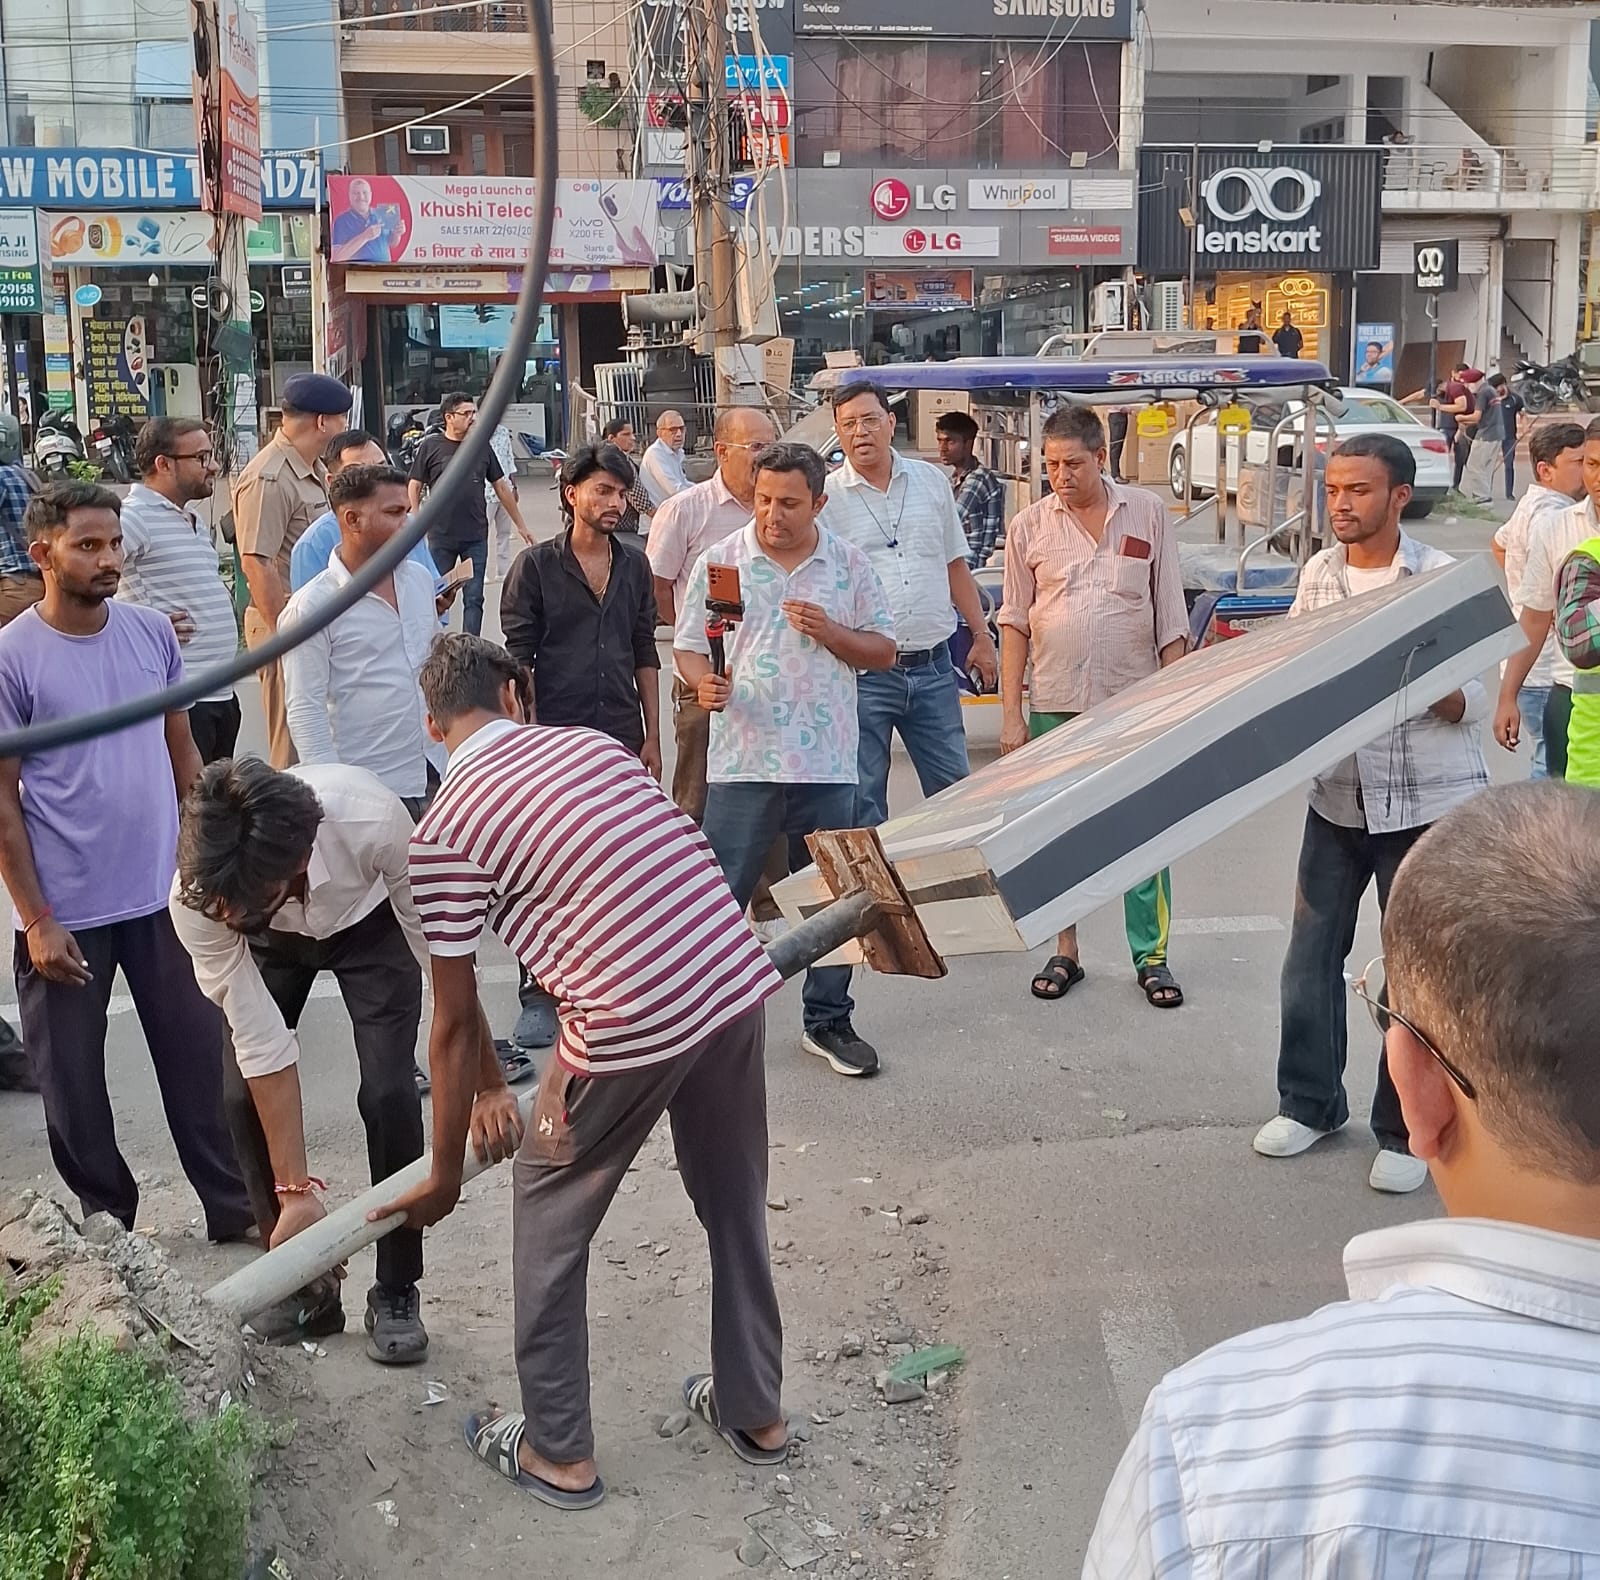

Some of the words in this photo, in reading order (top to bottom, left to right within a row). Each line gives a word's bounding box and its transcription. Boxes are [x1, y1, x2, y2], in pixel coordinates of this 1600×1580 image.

[803, 3, 840, 14] Service
[0, 157, 34, 198] W
[51, 157, 176, 198] MOBILE
[445, 184, 477, 198] Mega
[480, 184, 521, 196] Launch
[915, 185, 957, 210] LG
[982, 184, 1056, 201] Whirlpool
[420, 201, 482, 218] Khushi
[569, 216, 604, 227] vivo
[440, 226, 459, 235] SALE
[463, 226, 490, 236] START
[569, 230, 591, 238] X200
[593, 230, 605, 238] FE
[1054, 234, 1090, 242] SHARMA
[1090, 234, 1120, 242] VIDEOS
[931, 233, 961, 250] LG
[1195, 223, 1322, 254] lenskart
[12, 271, 32, 280] FOR
[0, 296, 35, 306] 91103
[1142, 370, 1215, 384] SARGAM
